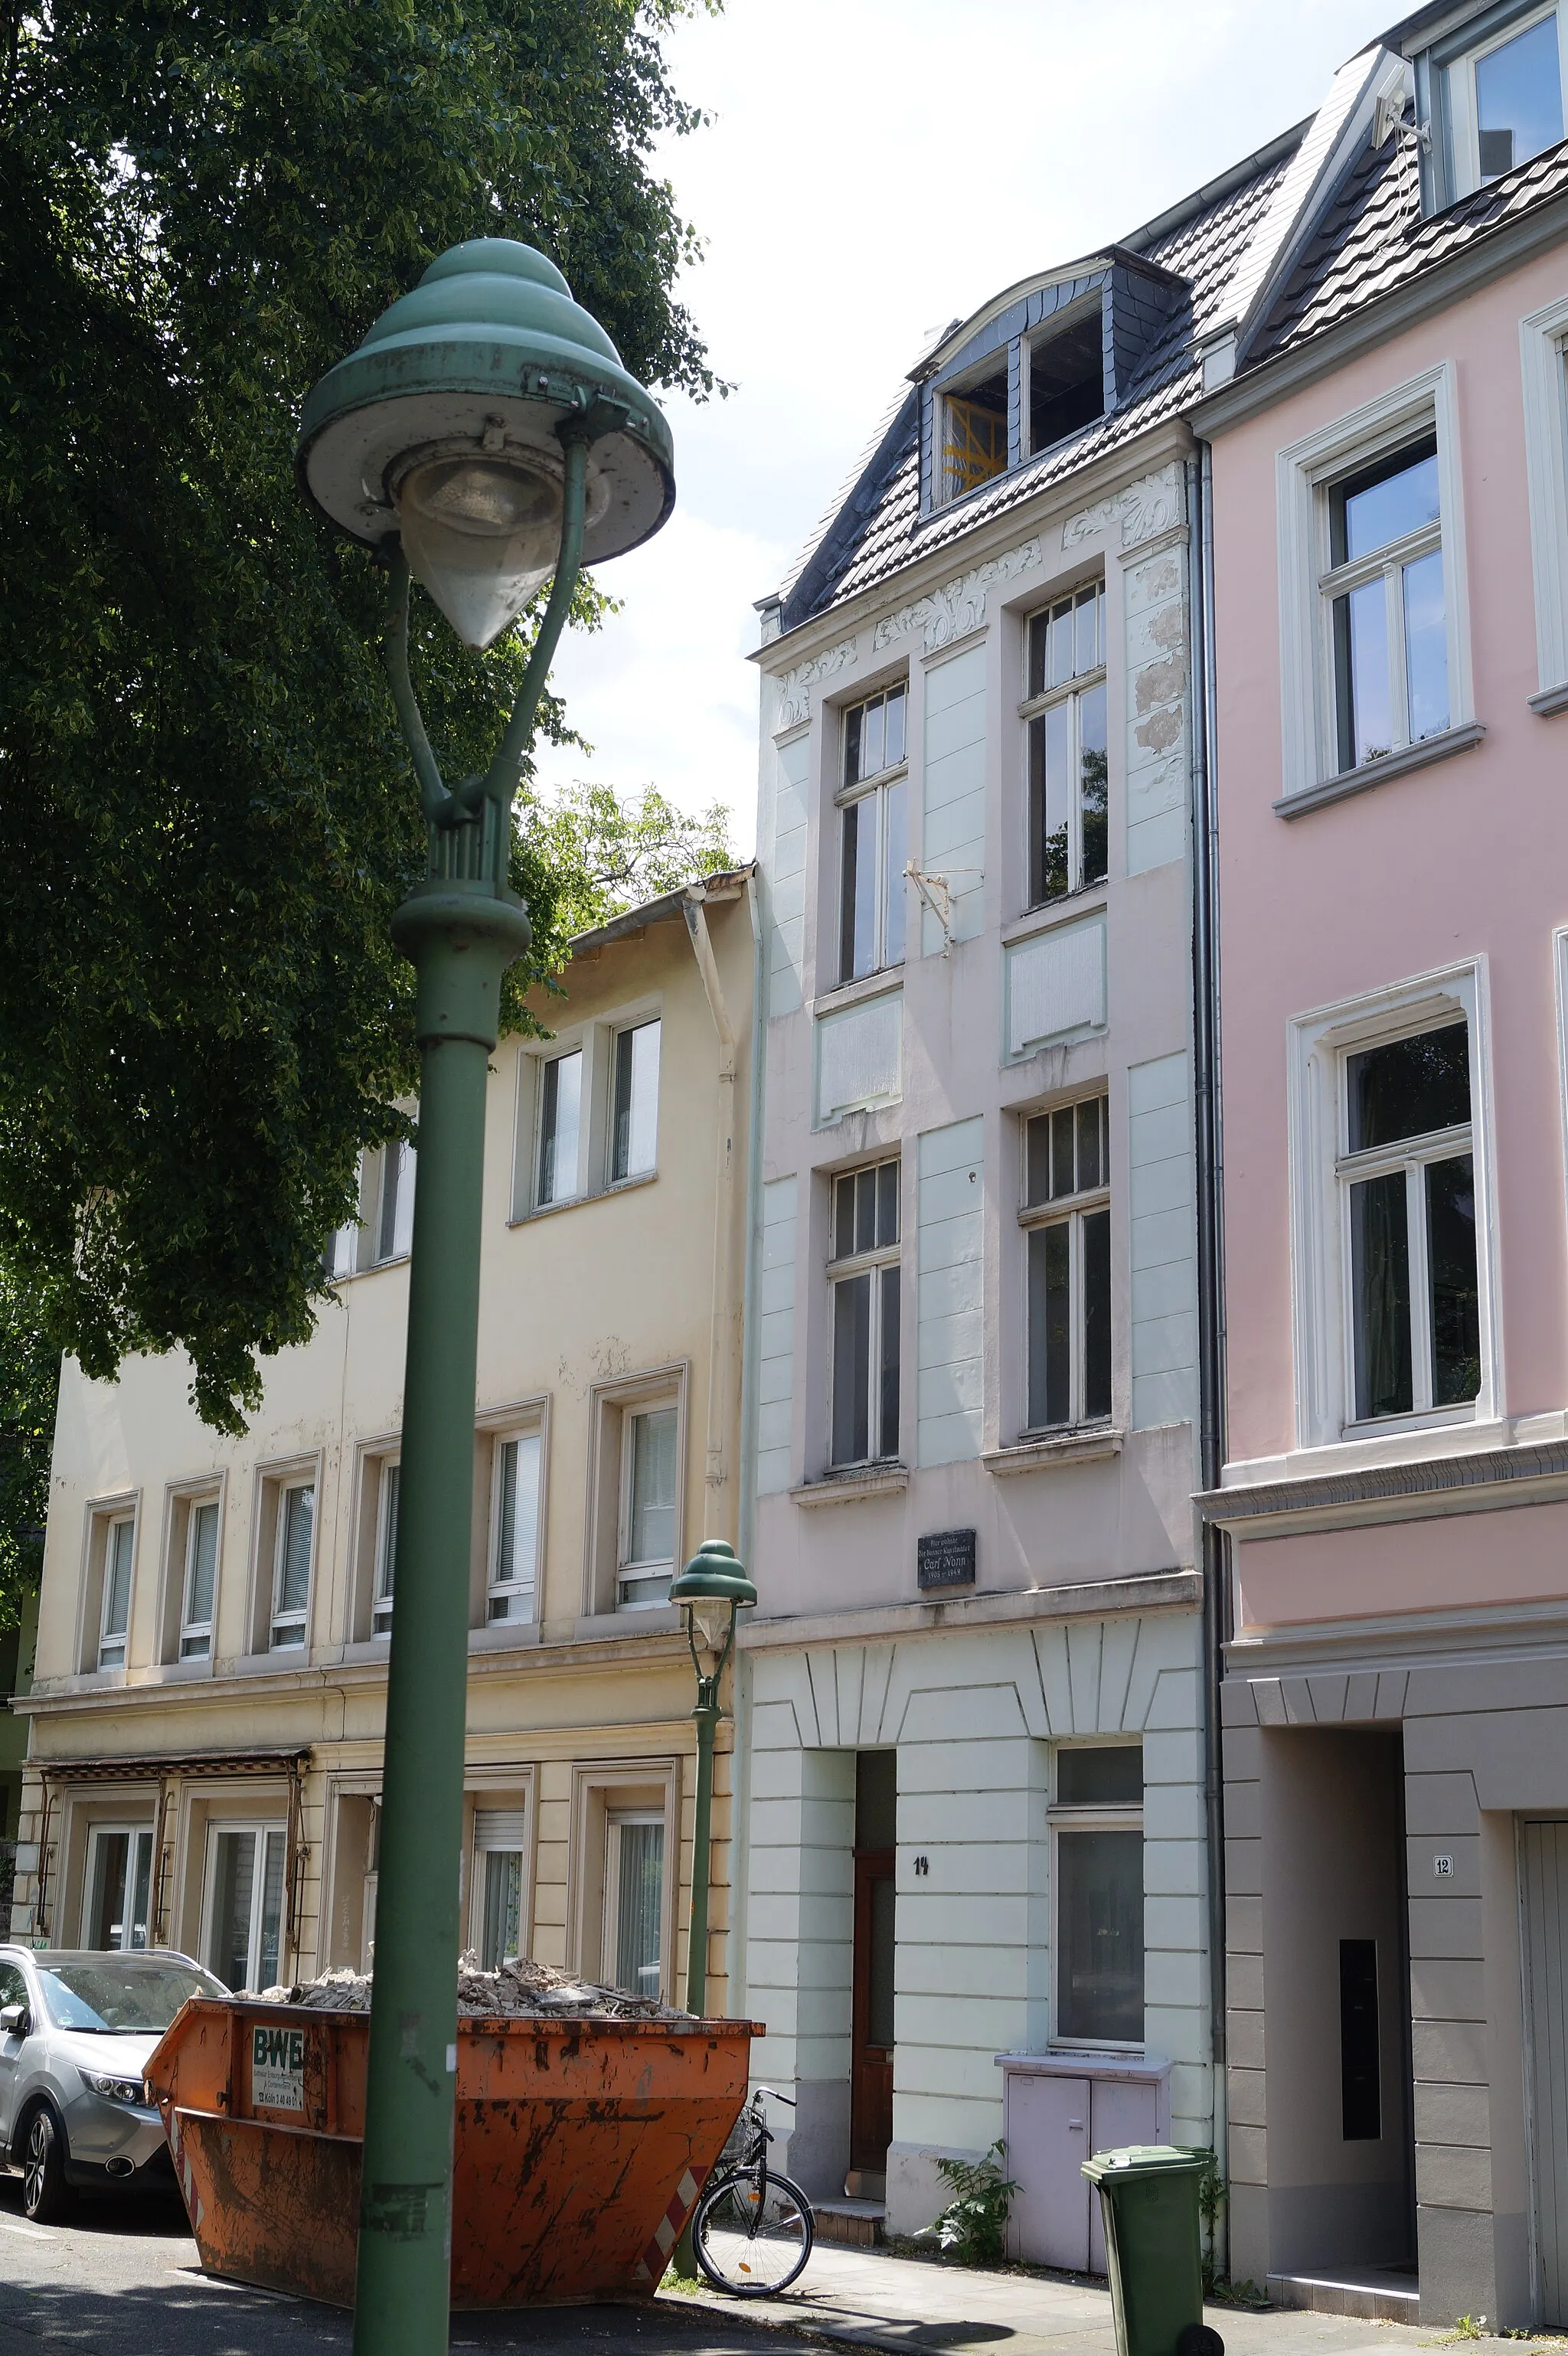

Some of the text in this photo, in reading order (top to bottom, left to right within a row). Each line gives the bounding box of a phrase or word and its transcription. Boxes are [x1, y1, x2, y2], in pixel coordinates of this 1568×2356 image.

[924, 1556, 966, 1570] Carl Nonn
[948, 1568, 961, 1577] 1949
[913, 1856, 929, 1875] 14
[1437, 1859, 1449, 1874] 12
[253, 2029, 303, 2070] BWE
[265, 2092, 276, 2104] Köln
[280, 2095, 286, 2105] 40
[286, 2096, 292, 2106] 49
